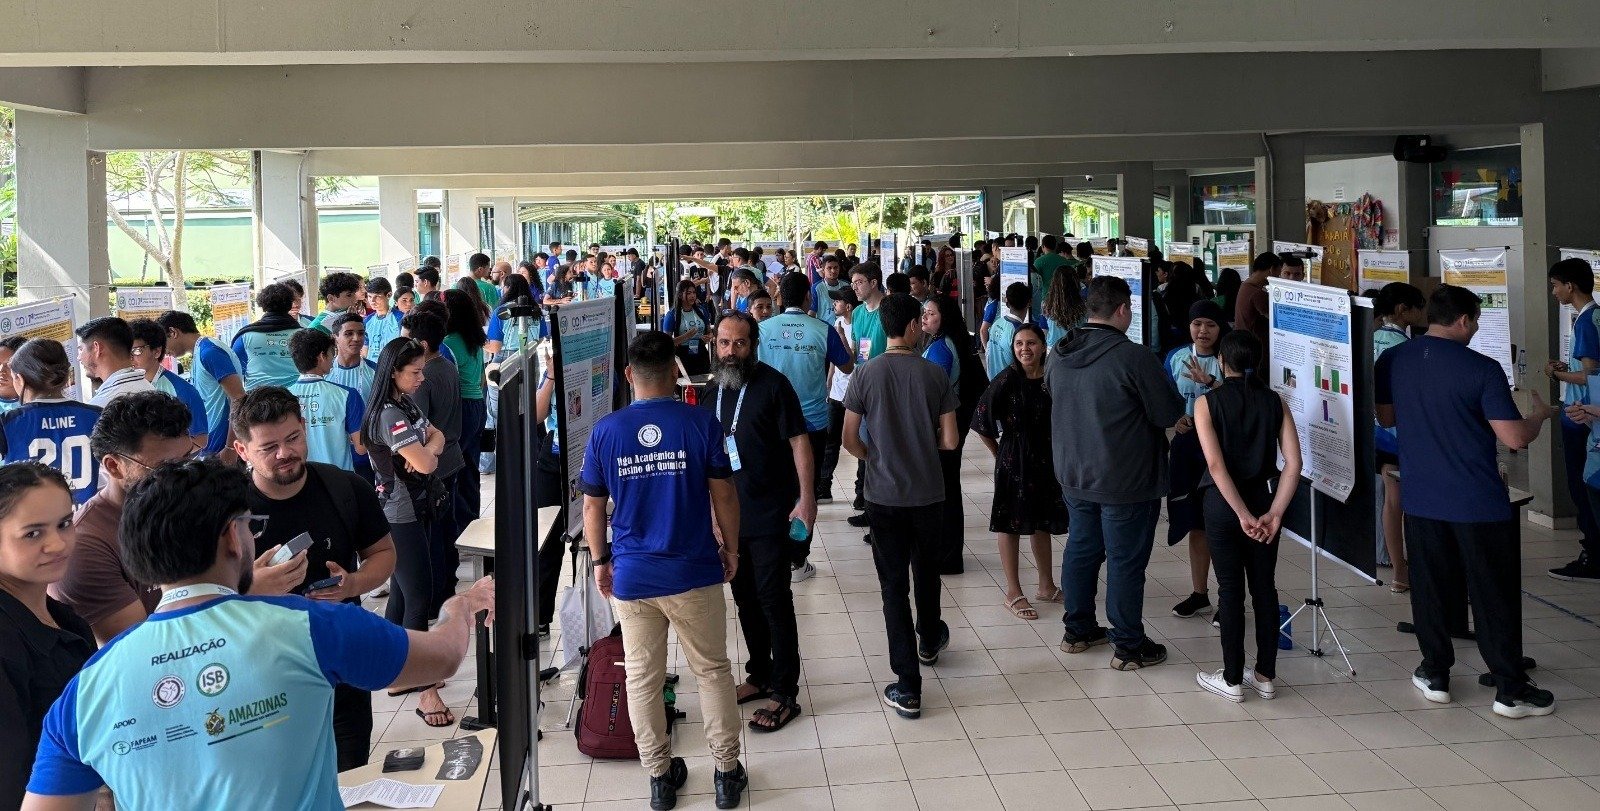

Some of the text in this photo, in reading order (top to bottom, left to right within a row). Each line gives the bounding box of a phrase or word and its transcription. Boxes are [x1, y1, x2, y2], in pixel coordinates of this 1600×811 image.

[41, 415, 77, 430] ALINE
[28, 434, 93, 490] 20
[634, 450, 676, 464] Acadêmica
[618, 465, 643, 477] Ensino
[645, 463, 656, 472] de
[150, 637, 227, 667] REALIZAÇÃO
[202, 669, 225, 688] ISB
[228, 692, 288, 726] AMAZONAS
[112, 717, 137, 731] APOIO
[130, 734, 158, 748] FAPEAM
